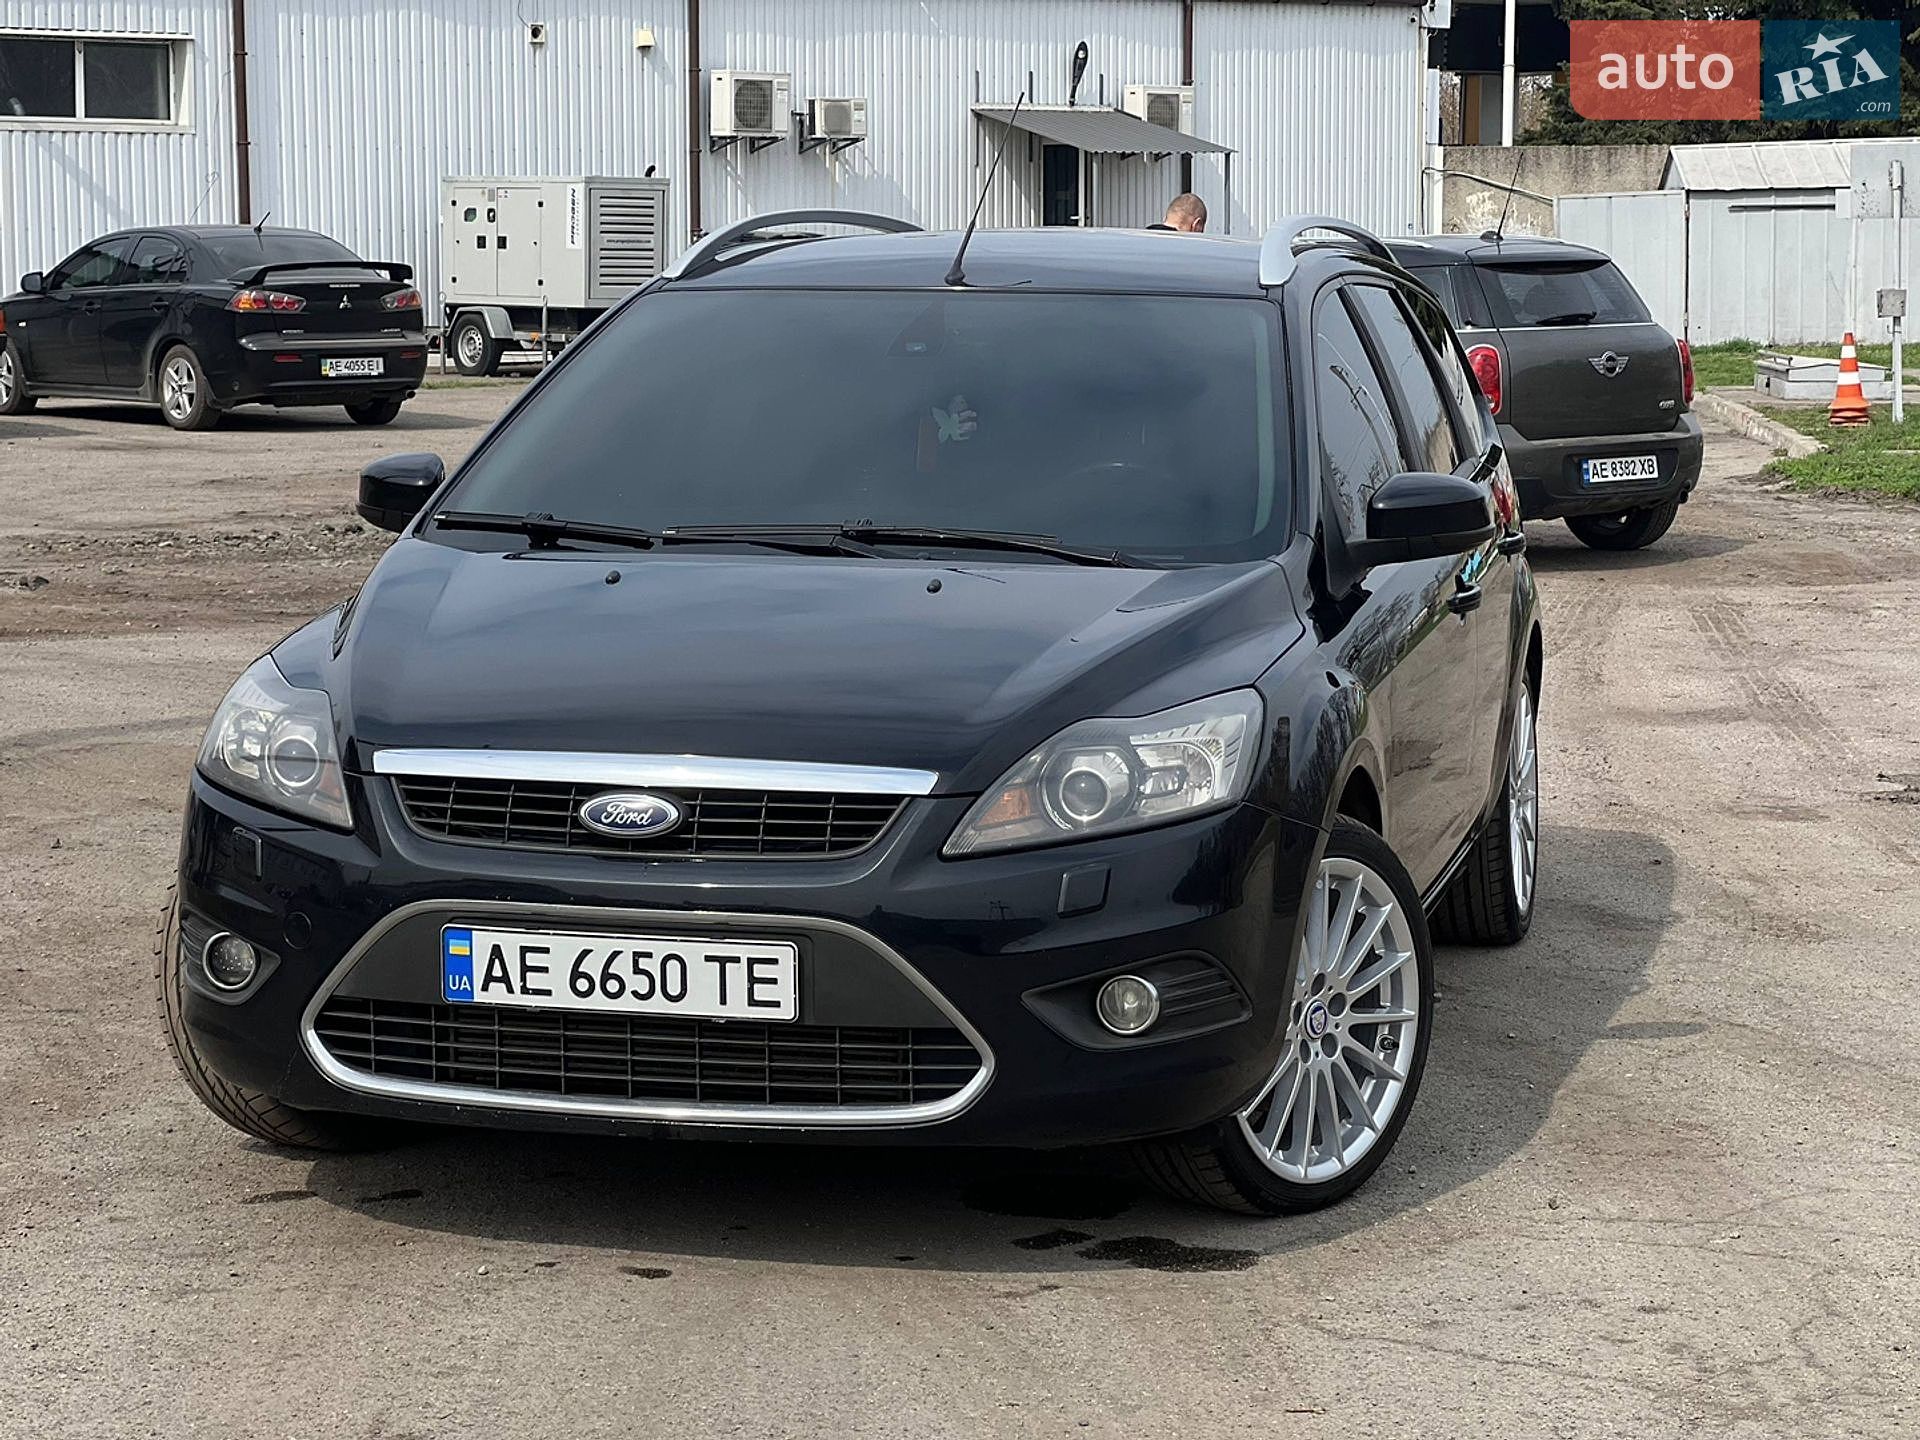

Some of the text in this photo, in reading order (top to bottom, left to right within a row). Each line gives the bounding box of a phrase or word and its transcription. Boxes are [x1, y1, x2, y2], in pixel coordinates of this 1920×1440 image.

[328, 360, 342, 372] AE
[1592, 462, 1609, 479] AE
[1638, 458, 1656, 476] XB
[601, 801, 654, 826] Ford
[449, 974, 471, 992] UA
[480, 943, 782, 1008] AE 6650 TE
